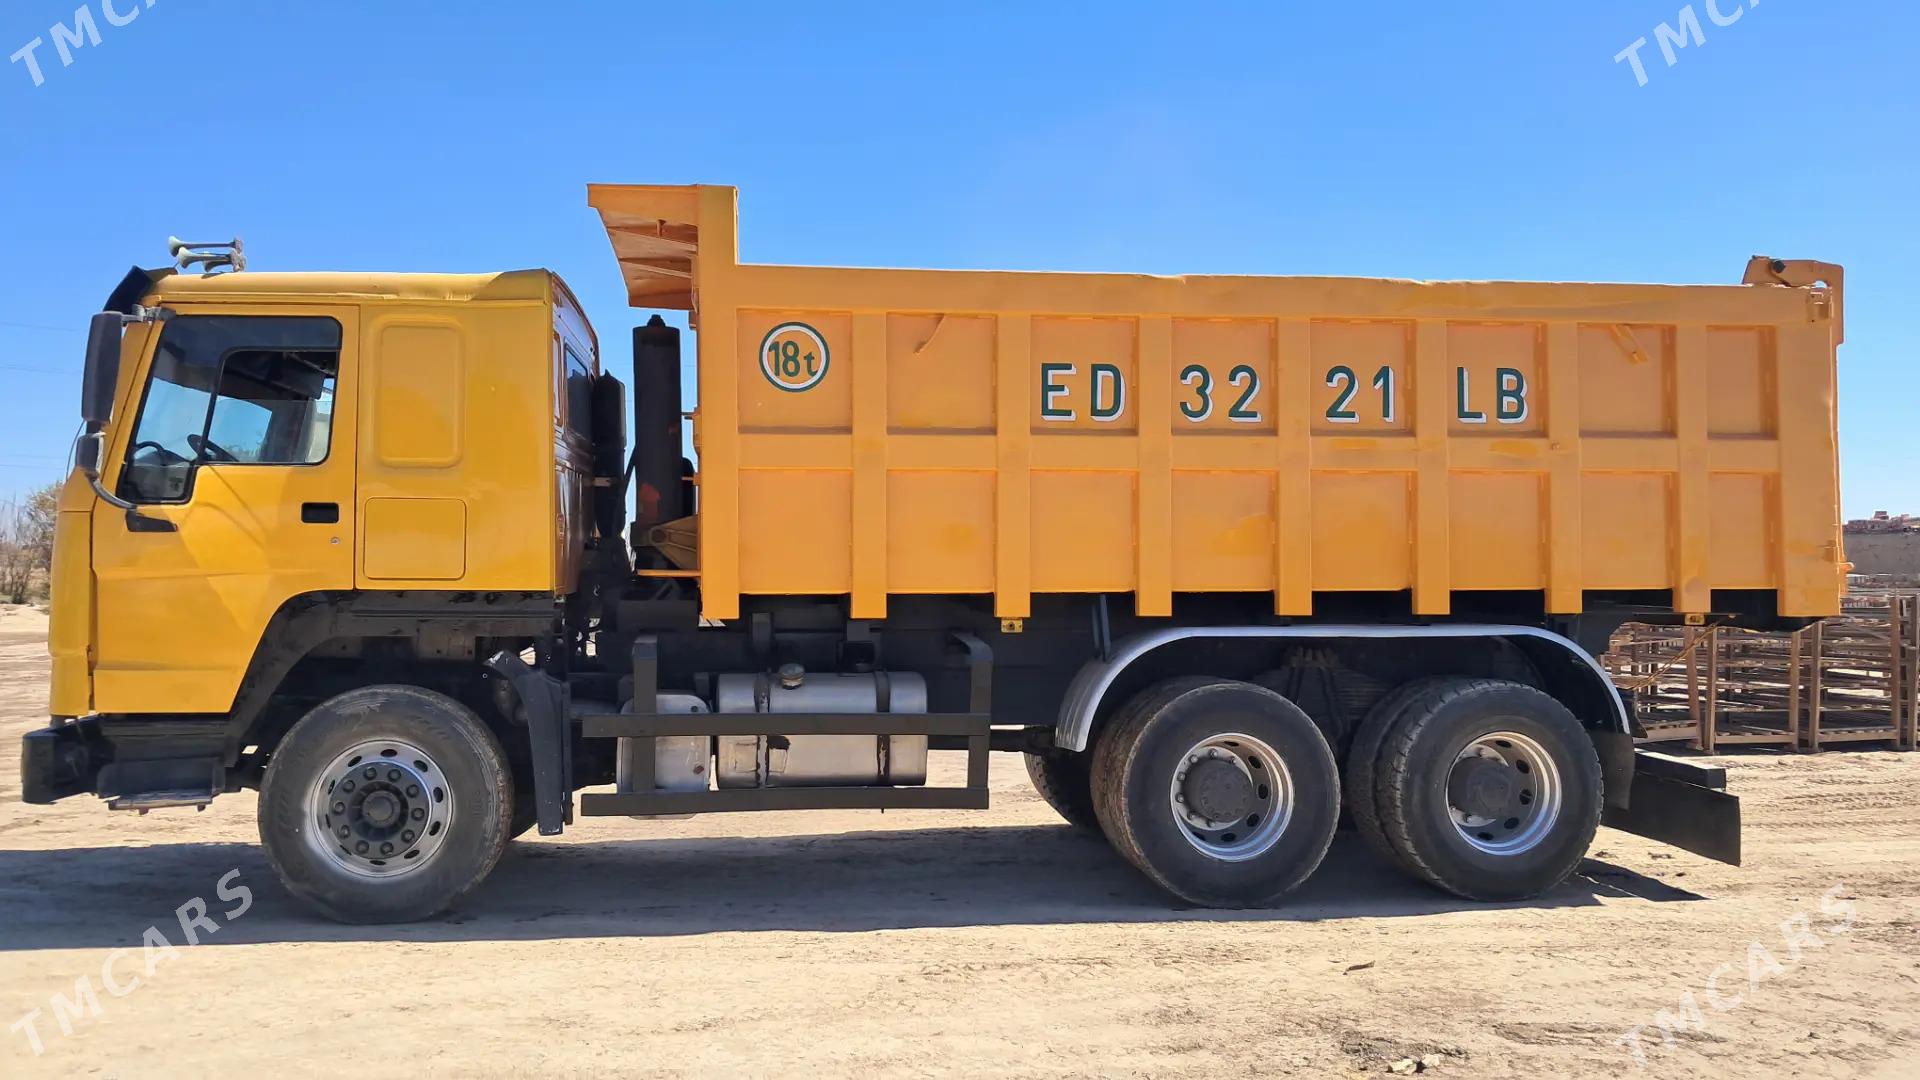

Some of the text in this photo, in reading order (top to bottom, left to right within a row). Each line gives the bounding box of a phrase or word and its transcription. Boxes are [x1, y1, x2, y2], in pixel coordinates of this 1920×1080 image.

[768, 340, 818, 377] 18t
[1041, 363, 1528, 424] ED 32 21 LB
